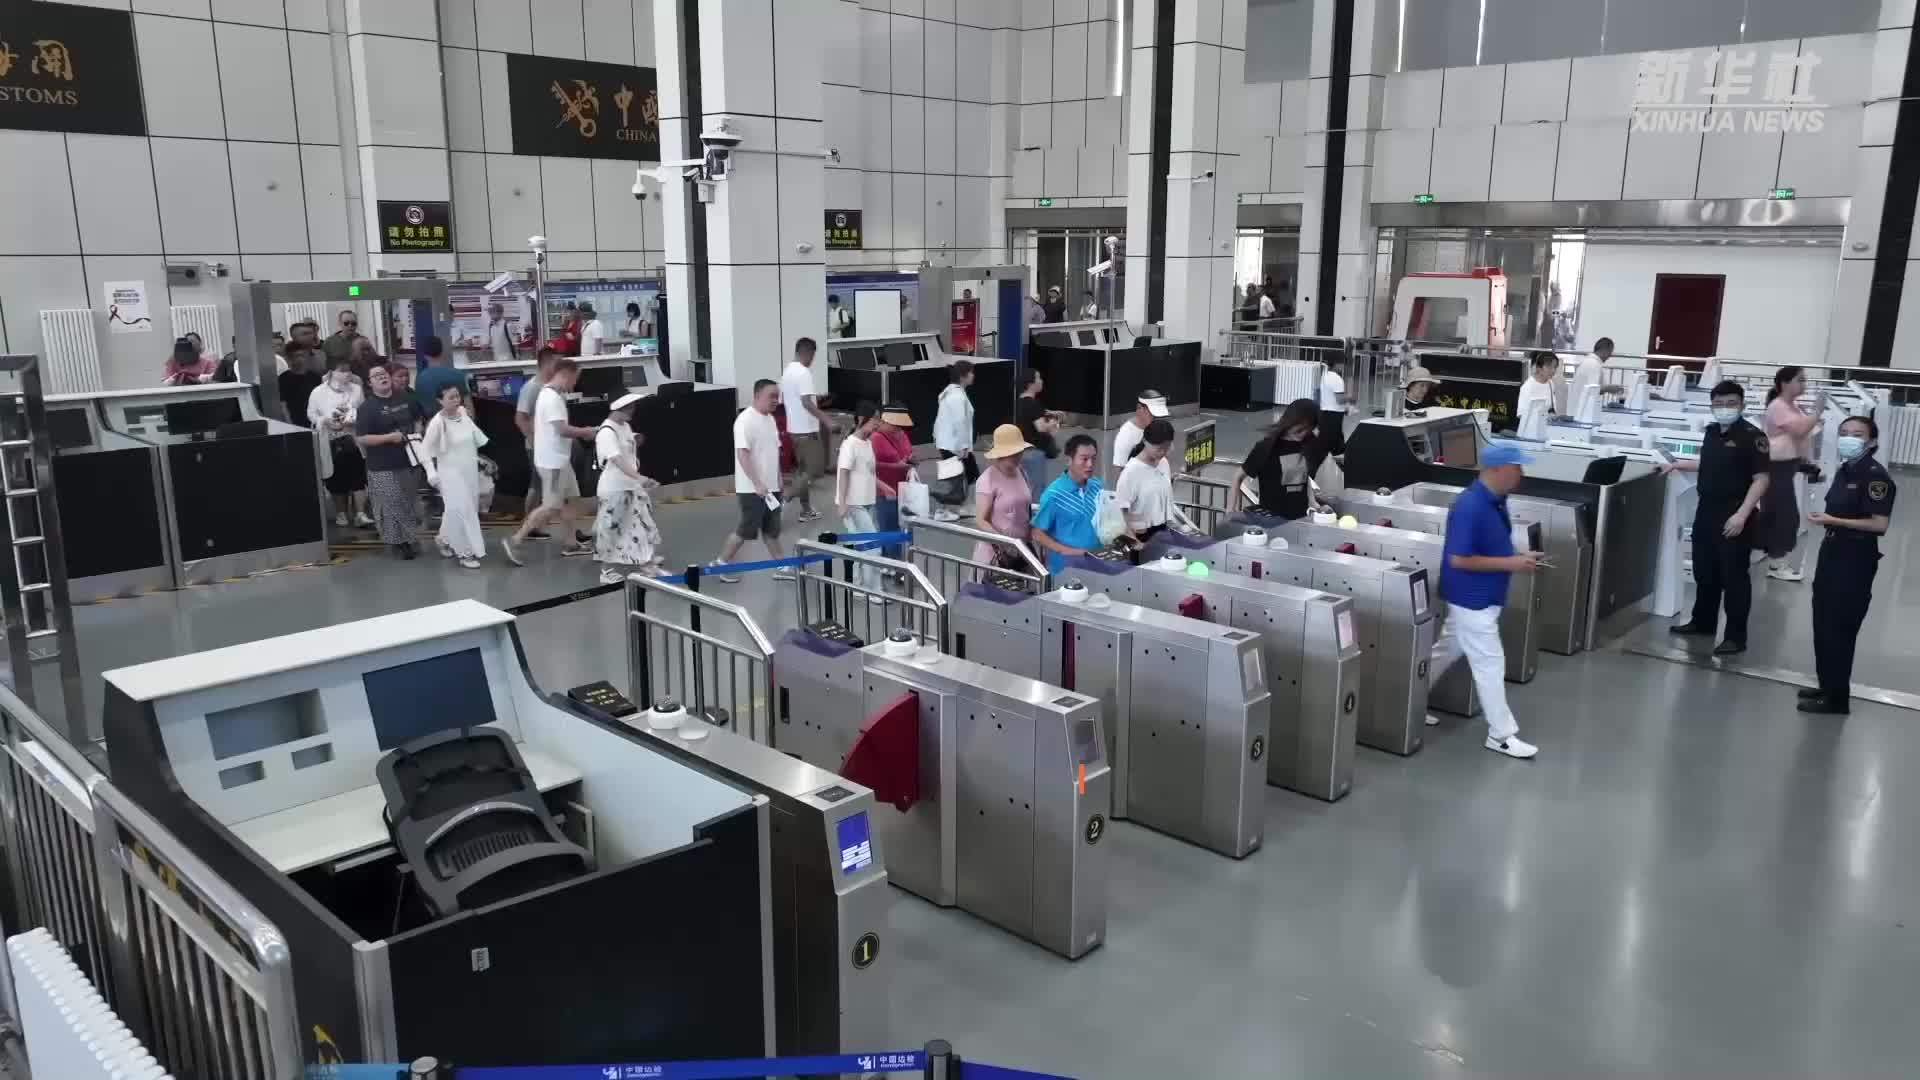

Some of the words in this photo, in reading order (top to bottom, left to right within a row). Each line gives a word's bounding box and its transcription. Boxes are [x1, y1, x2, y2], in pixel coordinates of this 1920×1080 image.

[616, 128, 657, 143] CHINA
[388, 226, 444, 238] 请勿拍照
